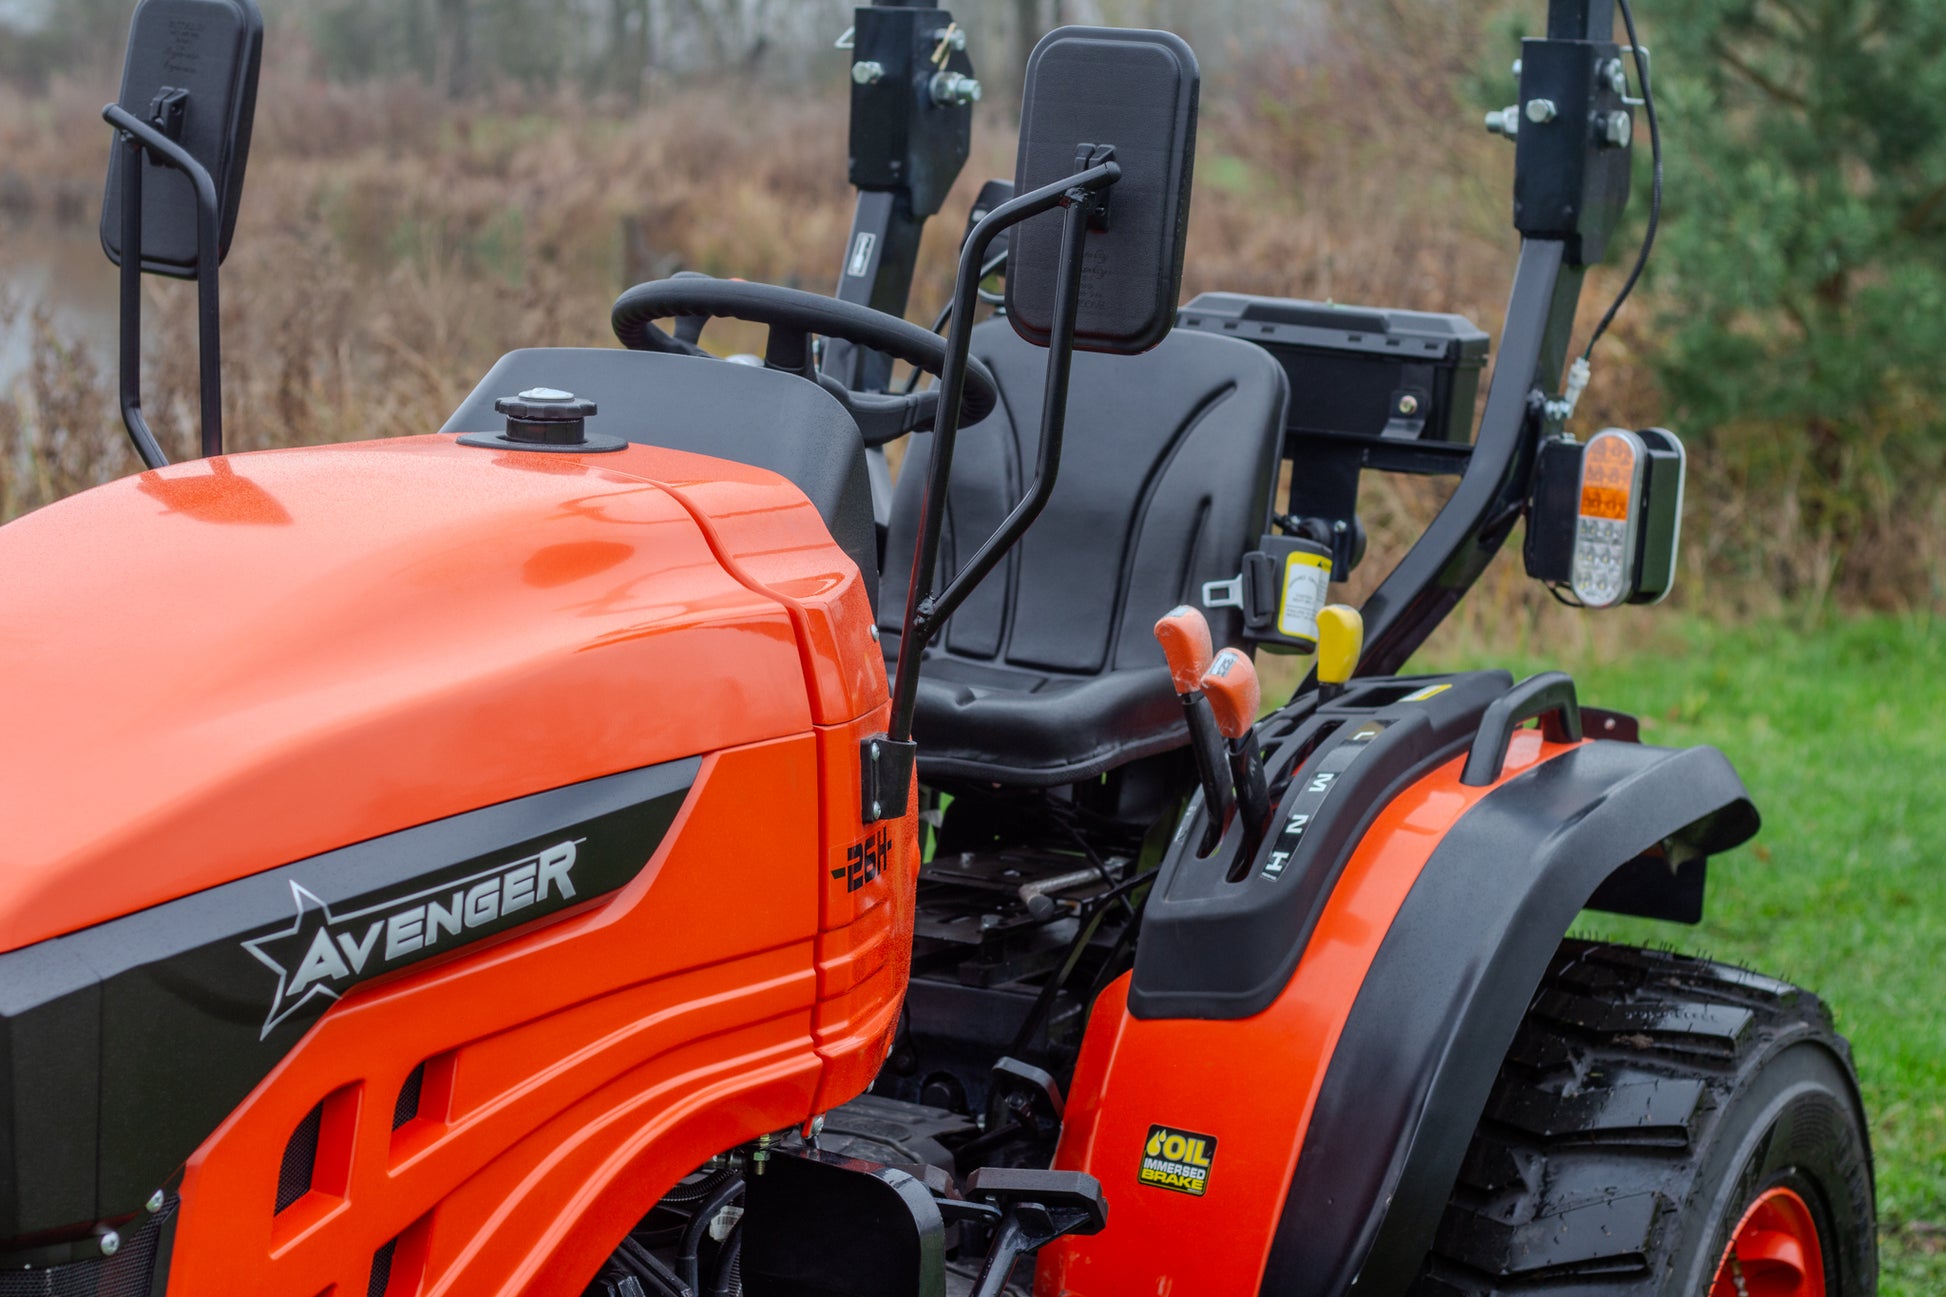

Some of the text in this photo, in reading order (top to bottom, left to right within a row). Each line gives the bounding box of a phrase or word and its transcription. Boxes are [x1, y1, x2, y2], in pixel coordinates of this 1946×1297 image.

[1264, 851, 1290, 872] H
[285, 840, 577, 997] AVENGER
[1162, 1134, 1210, 1168] OIL
[1141, 1168, 1205, 1191] BRAKE
[1143, 1157, 1206, 1180] IMMERSED
